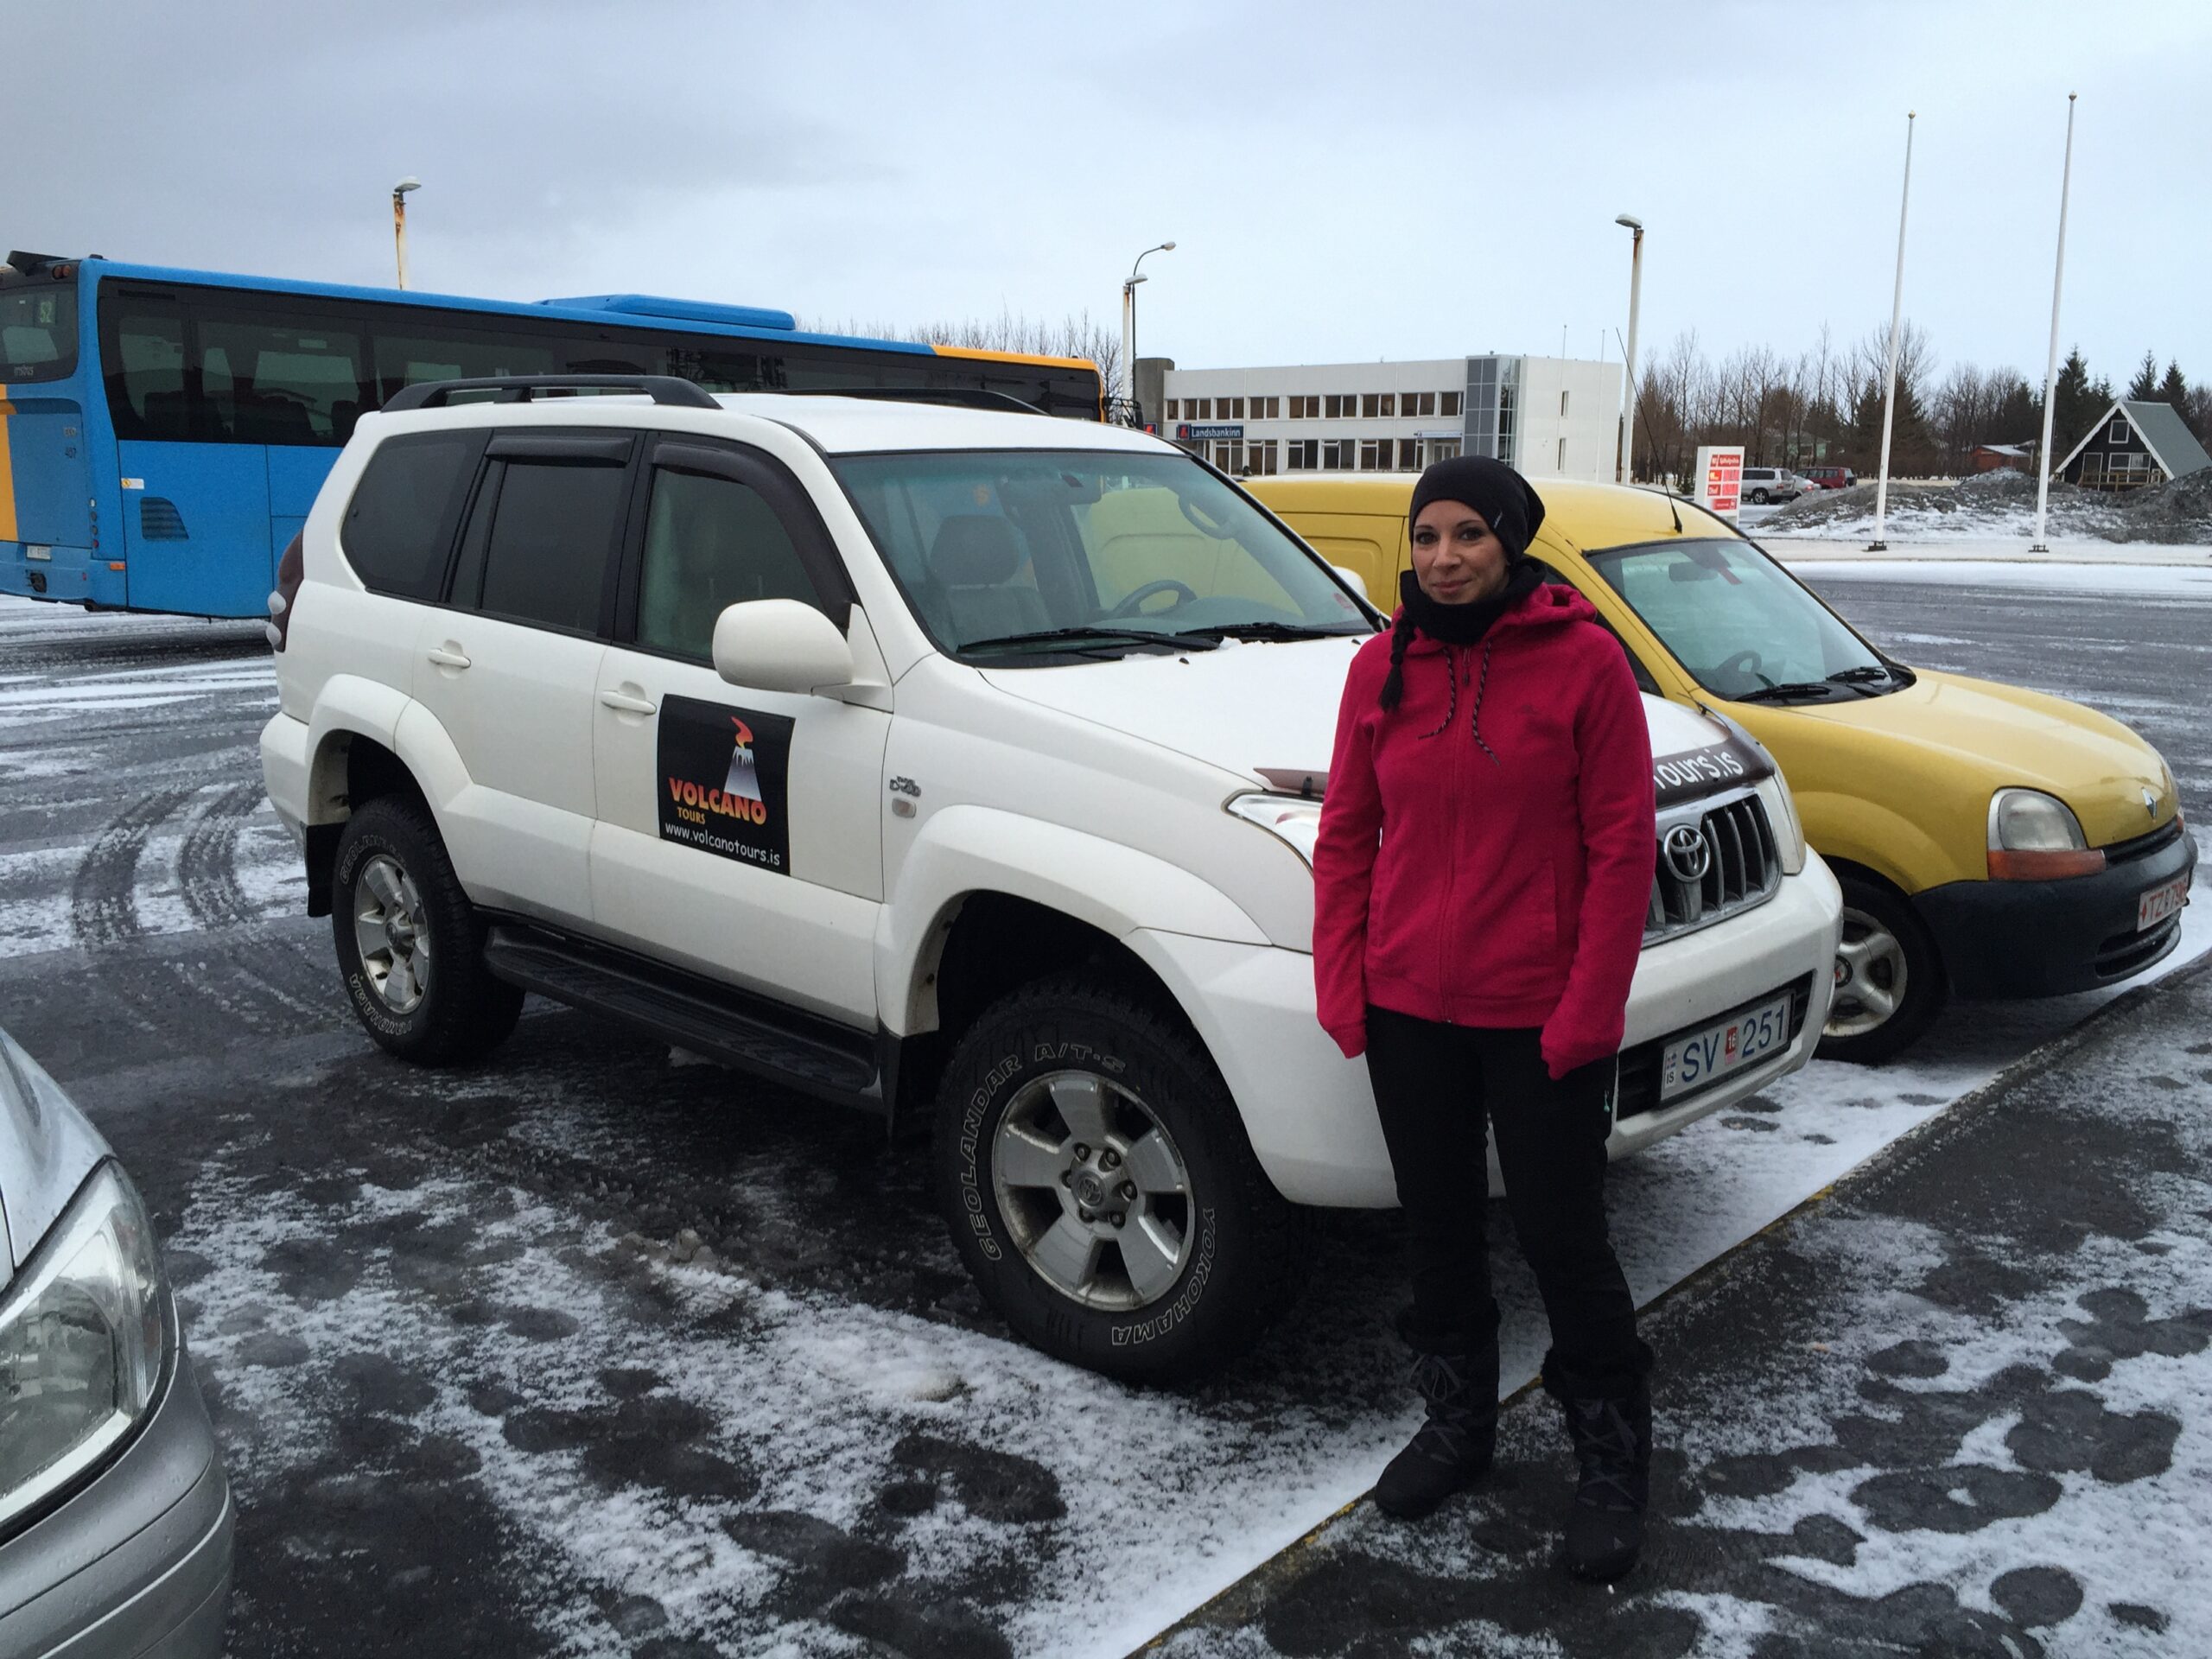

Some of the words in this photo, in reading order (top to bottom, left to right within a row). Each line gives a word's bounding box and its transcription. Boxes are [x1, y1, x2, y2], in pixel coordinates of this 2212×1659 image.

[1192, 427, 1241, 438] Landsbankinn
[669, 777, 767, 825] VOLCANO
[677, 806, 706, 825] TOURS
[664, 822, 780, 866] www.volcanotours.is
[1681, 1033, 1720, 1083] SV
[1741, 1004, 1786, 1058] 251
[1666, 1071, 1675, 1085] IS
[960, 1054, 1023, 1261] GEOLANDAR
[1111, 1208, 1216, 1346] YOKOHAMA
